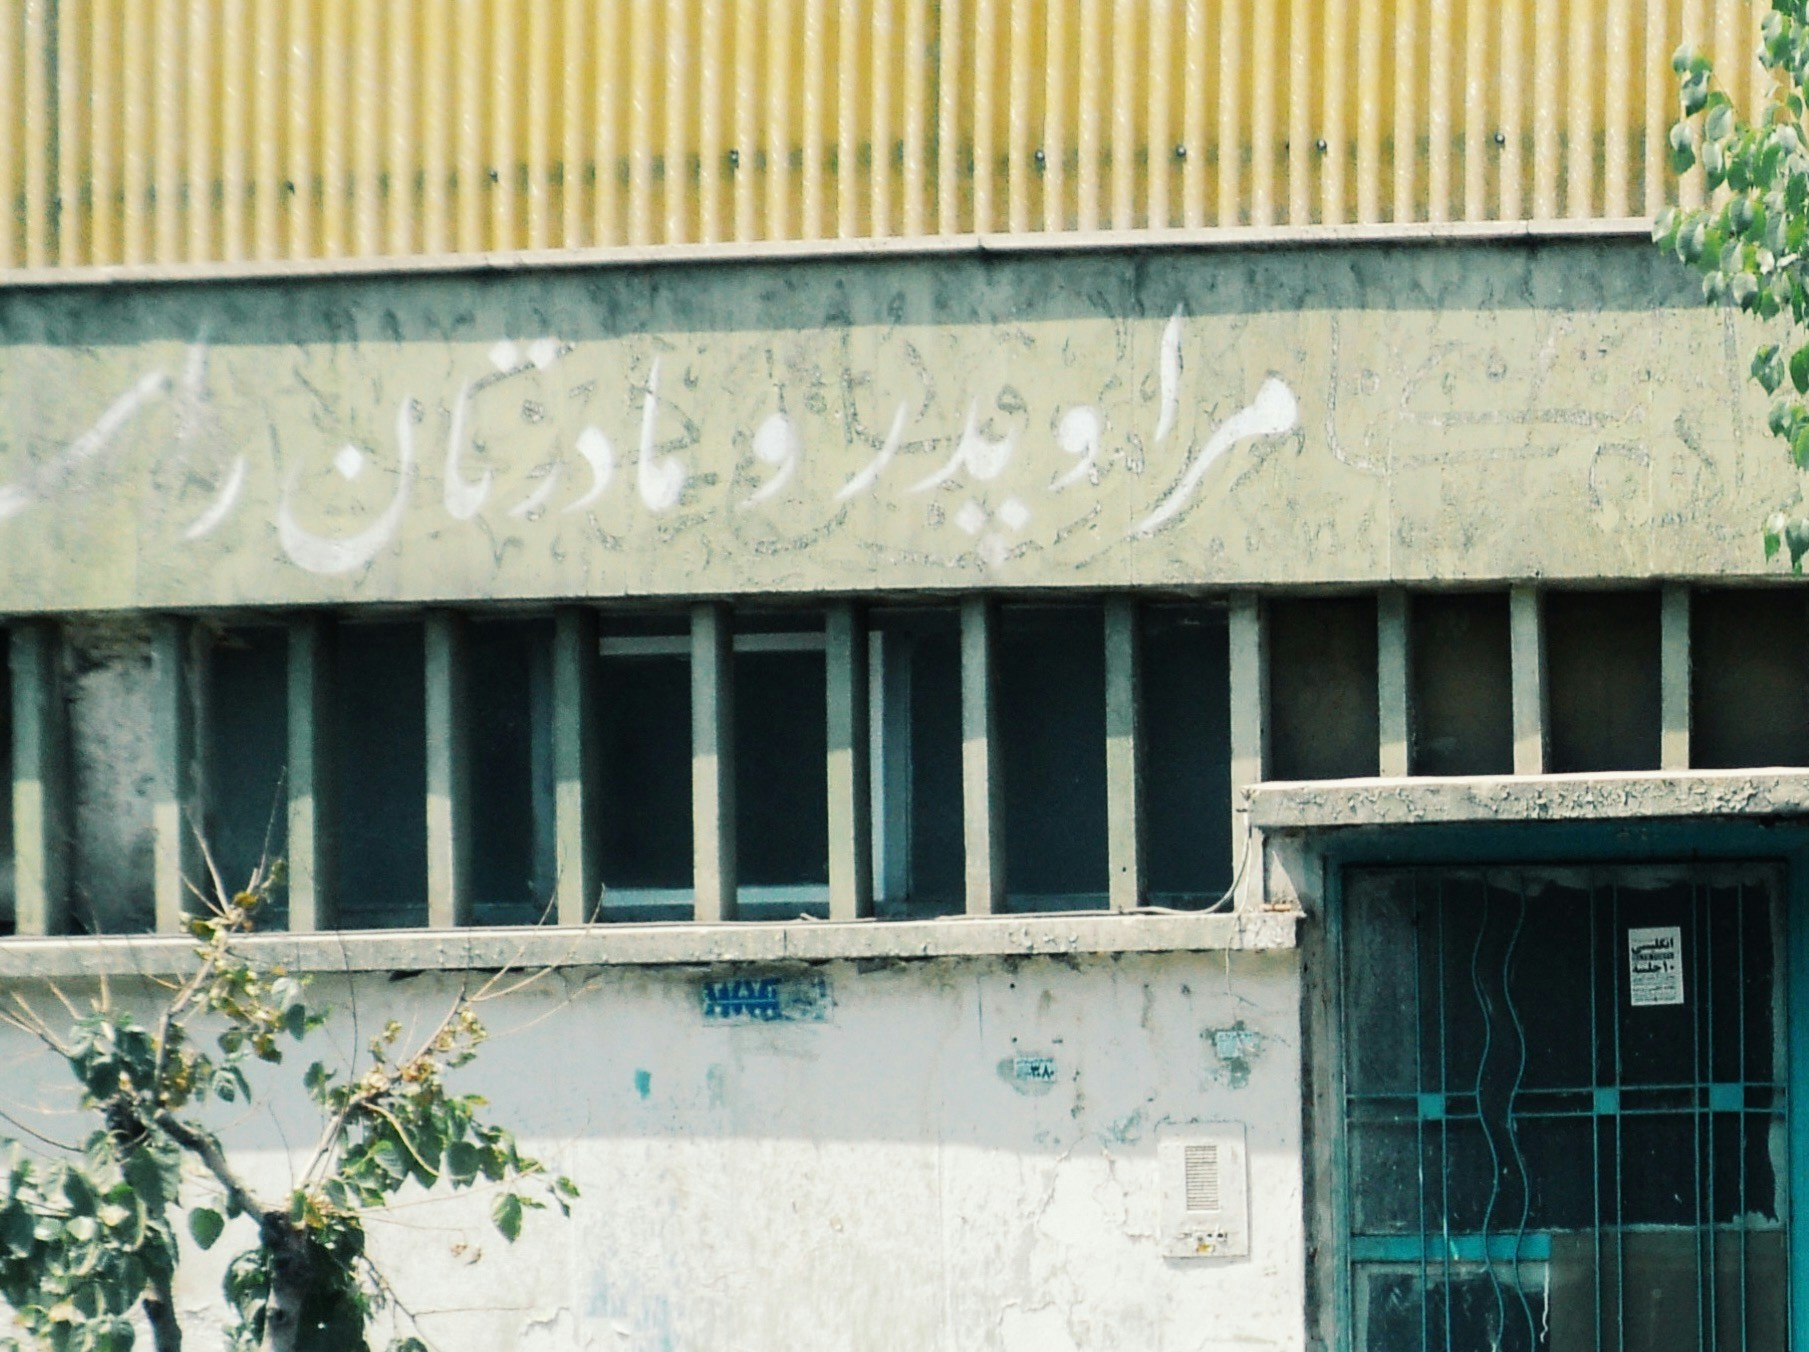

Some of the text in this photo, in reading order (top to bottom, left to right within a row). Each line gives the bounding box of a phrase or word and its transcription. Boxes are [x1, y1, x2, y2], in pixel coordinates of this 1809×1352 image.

[737, 410, 799, 510] و
[832, 394, 1033, 568] پدر
[1047, 403, 1104, 493] و
